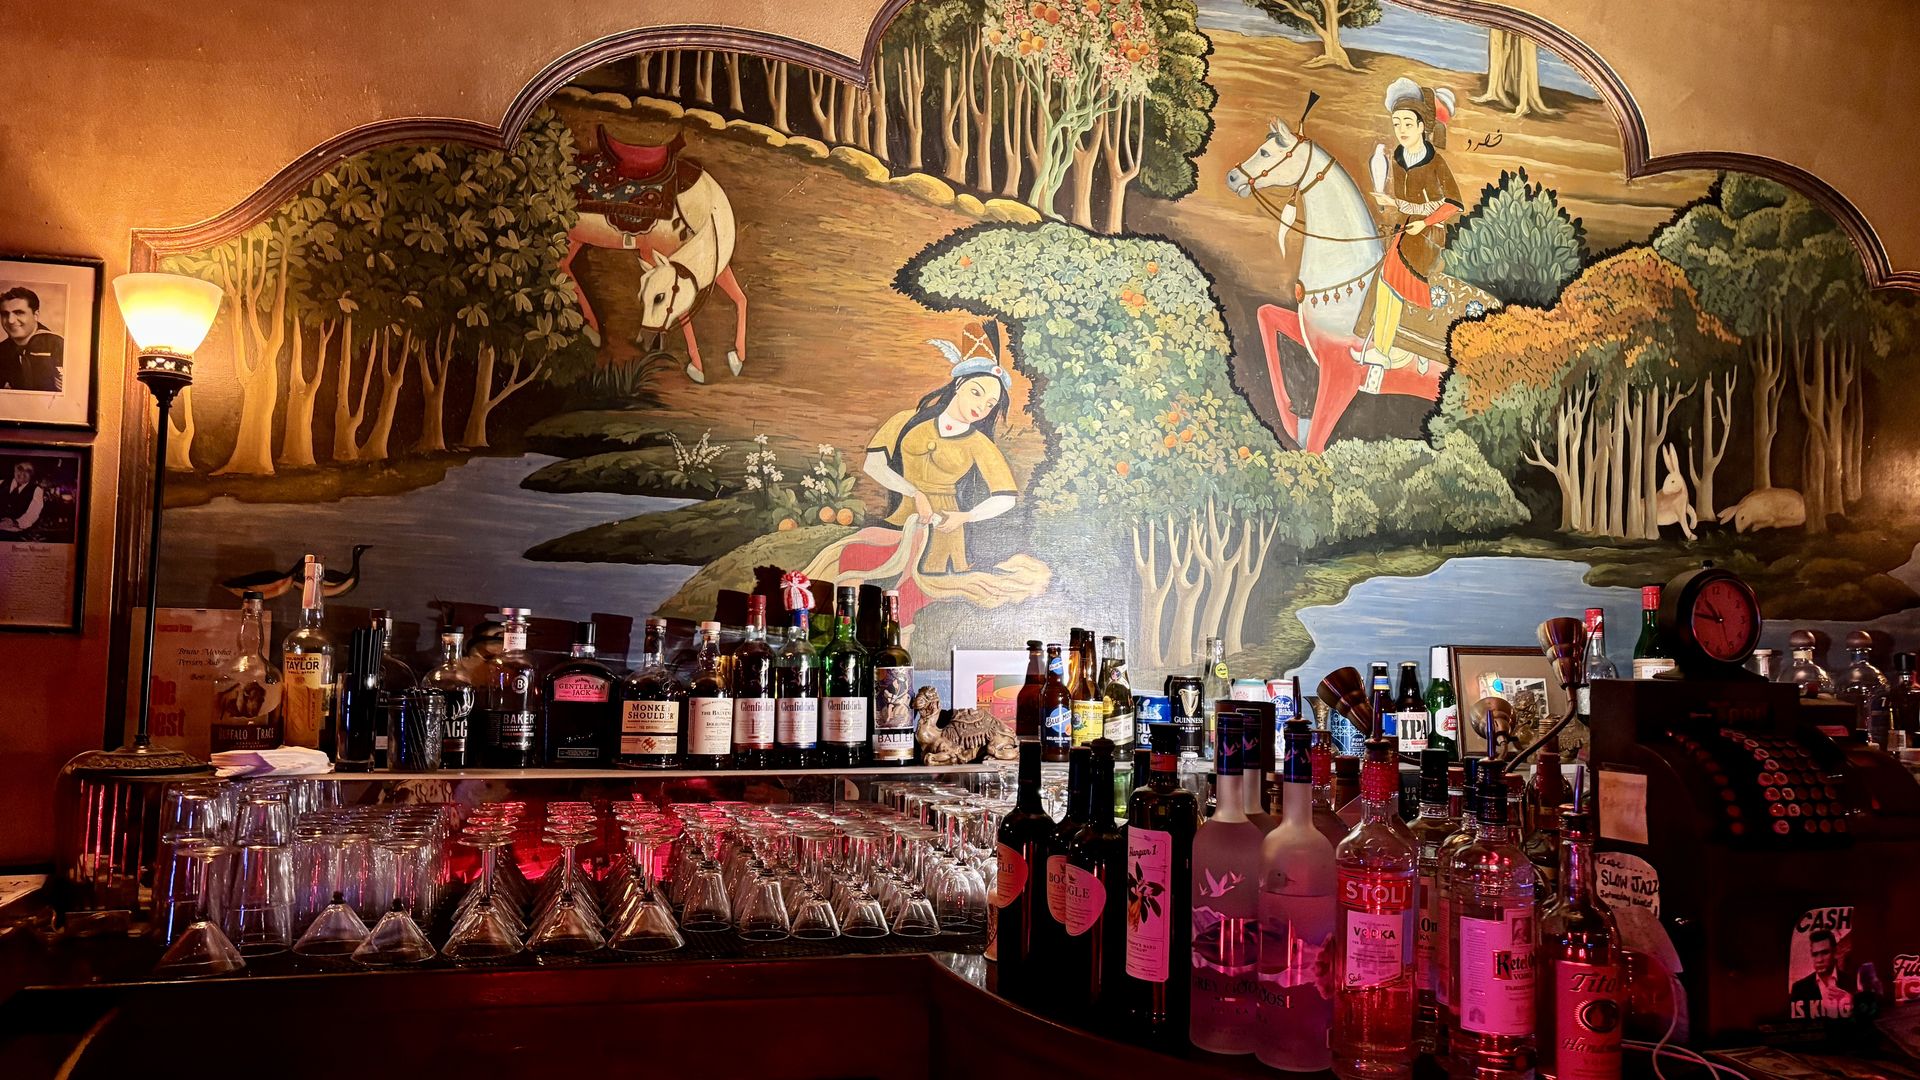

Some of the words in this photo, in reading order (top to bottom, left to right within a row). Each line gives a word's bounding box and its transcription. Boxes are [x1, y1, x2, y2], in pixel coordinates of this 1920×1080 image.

[286, 661, 320, 670] TAYLOR
[558, 683, 606, 691] GENTLEMAN
[780, 701, 815, 712] Glenfiddich
[827, 700, 862, 711] Glenfiddich
[1173, 716, 1204, 724] GUINNESS
[1400, 719, 1428, 740] IPA
[1601, 869, 1628, 889] SLOW
[1631, 875, 1659, 896] JAZZ
[1346, 880, 1407, 903] STOLI
[1797, 908, 1853, 933] CASH
[1353, 926, 1396, 940] VODKA
[1791, 1000, 1805, 1019] IS
[1809, 999, 1854, 1019] KING
